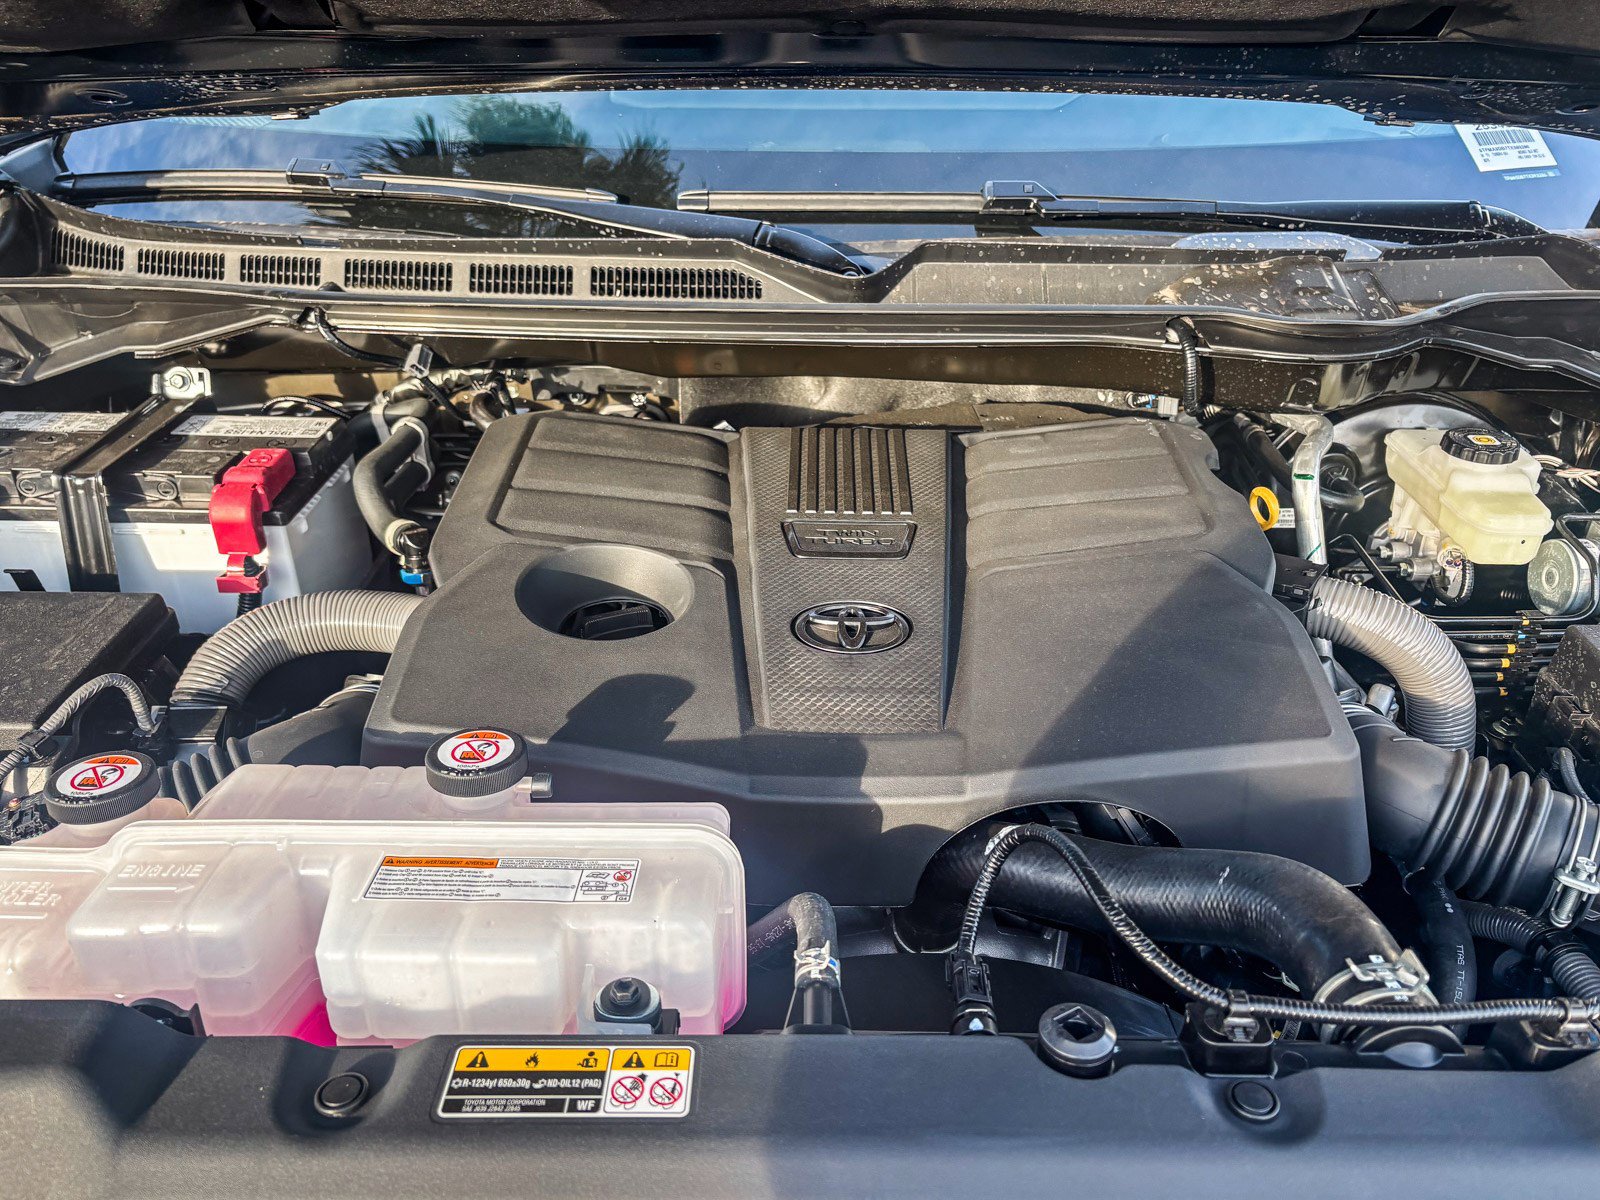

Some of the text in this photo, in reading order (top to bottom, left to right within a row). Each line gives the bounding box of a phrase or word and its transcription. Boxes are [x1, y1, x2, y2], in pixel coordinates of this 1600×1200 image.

[816, 528, 879, 537] TWIN
[805, 536, 896, 545] TURBO
[117, 864, 206, 878] ENGINE
[1456, 944, 1465, 966] TTAS
[462, 1078, 498, 1089] R-1234yf
[581, 1078, 602, 1089] (PAG)
[465, 1098, 546, 1106] TOYOTA MOTOR CORPORATION
[576, 1099, 596, 1111] WF
